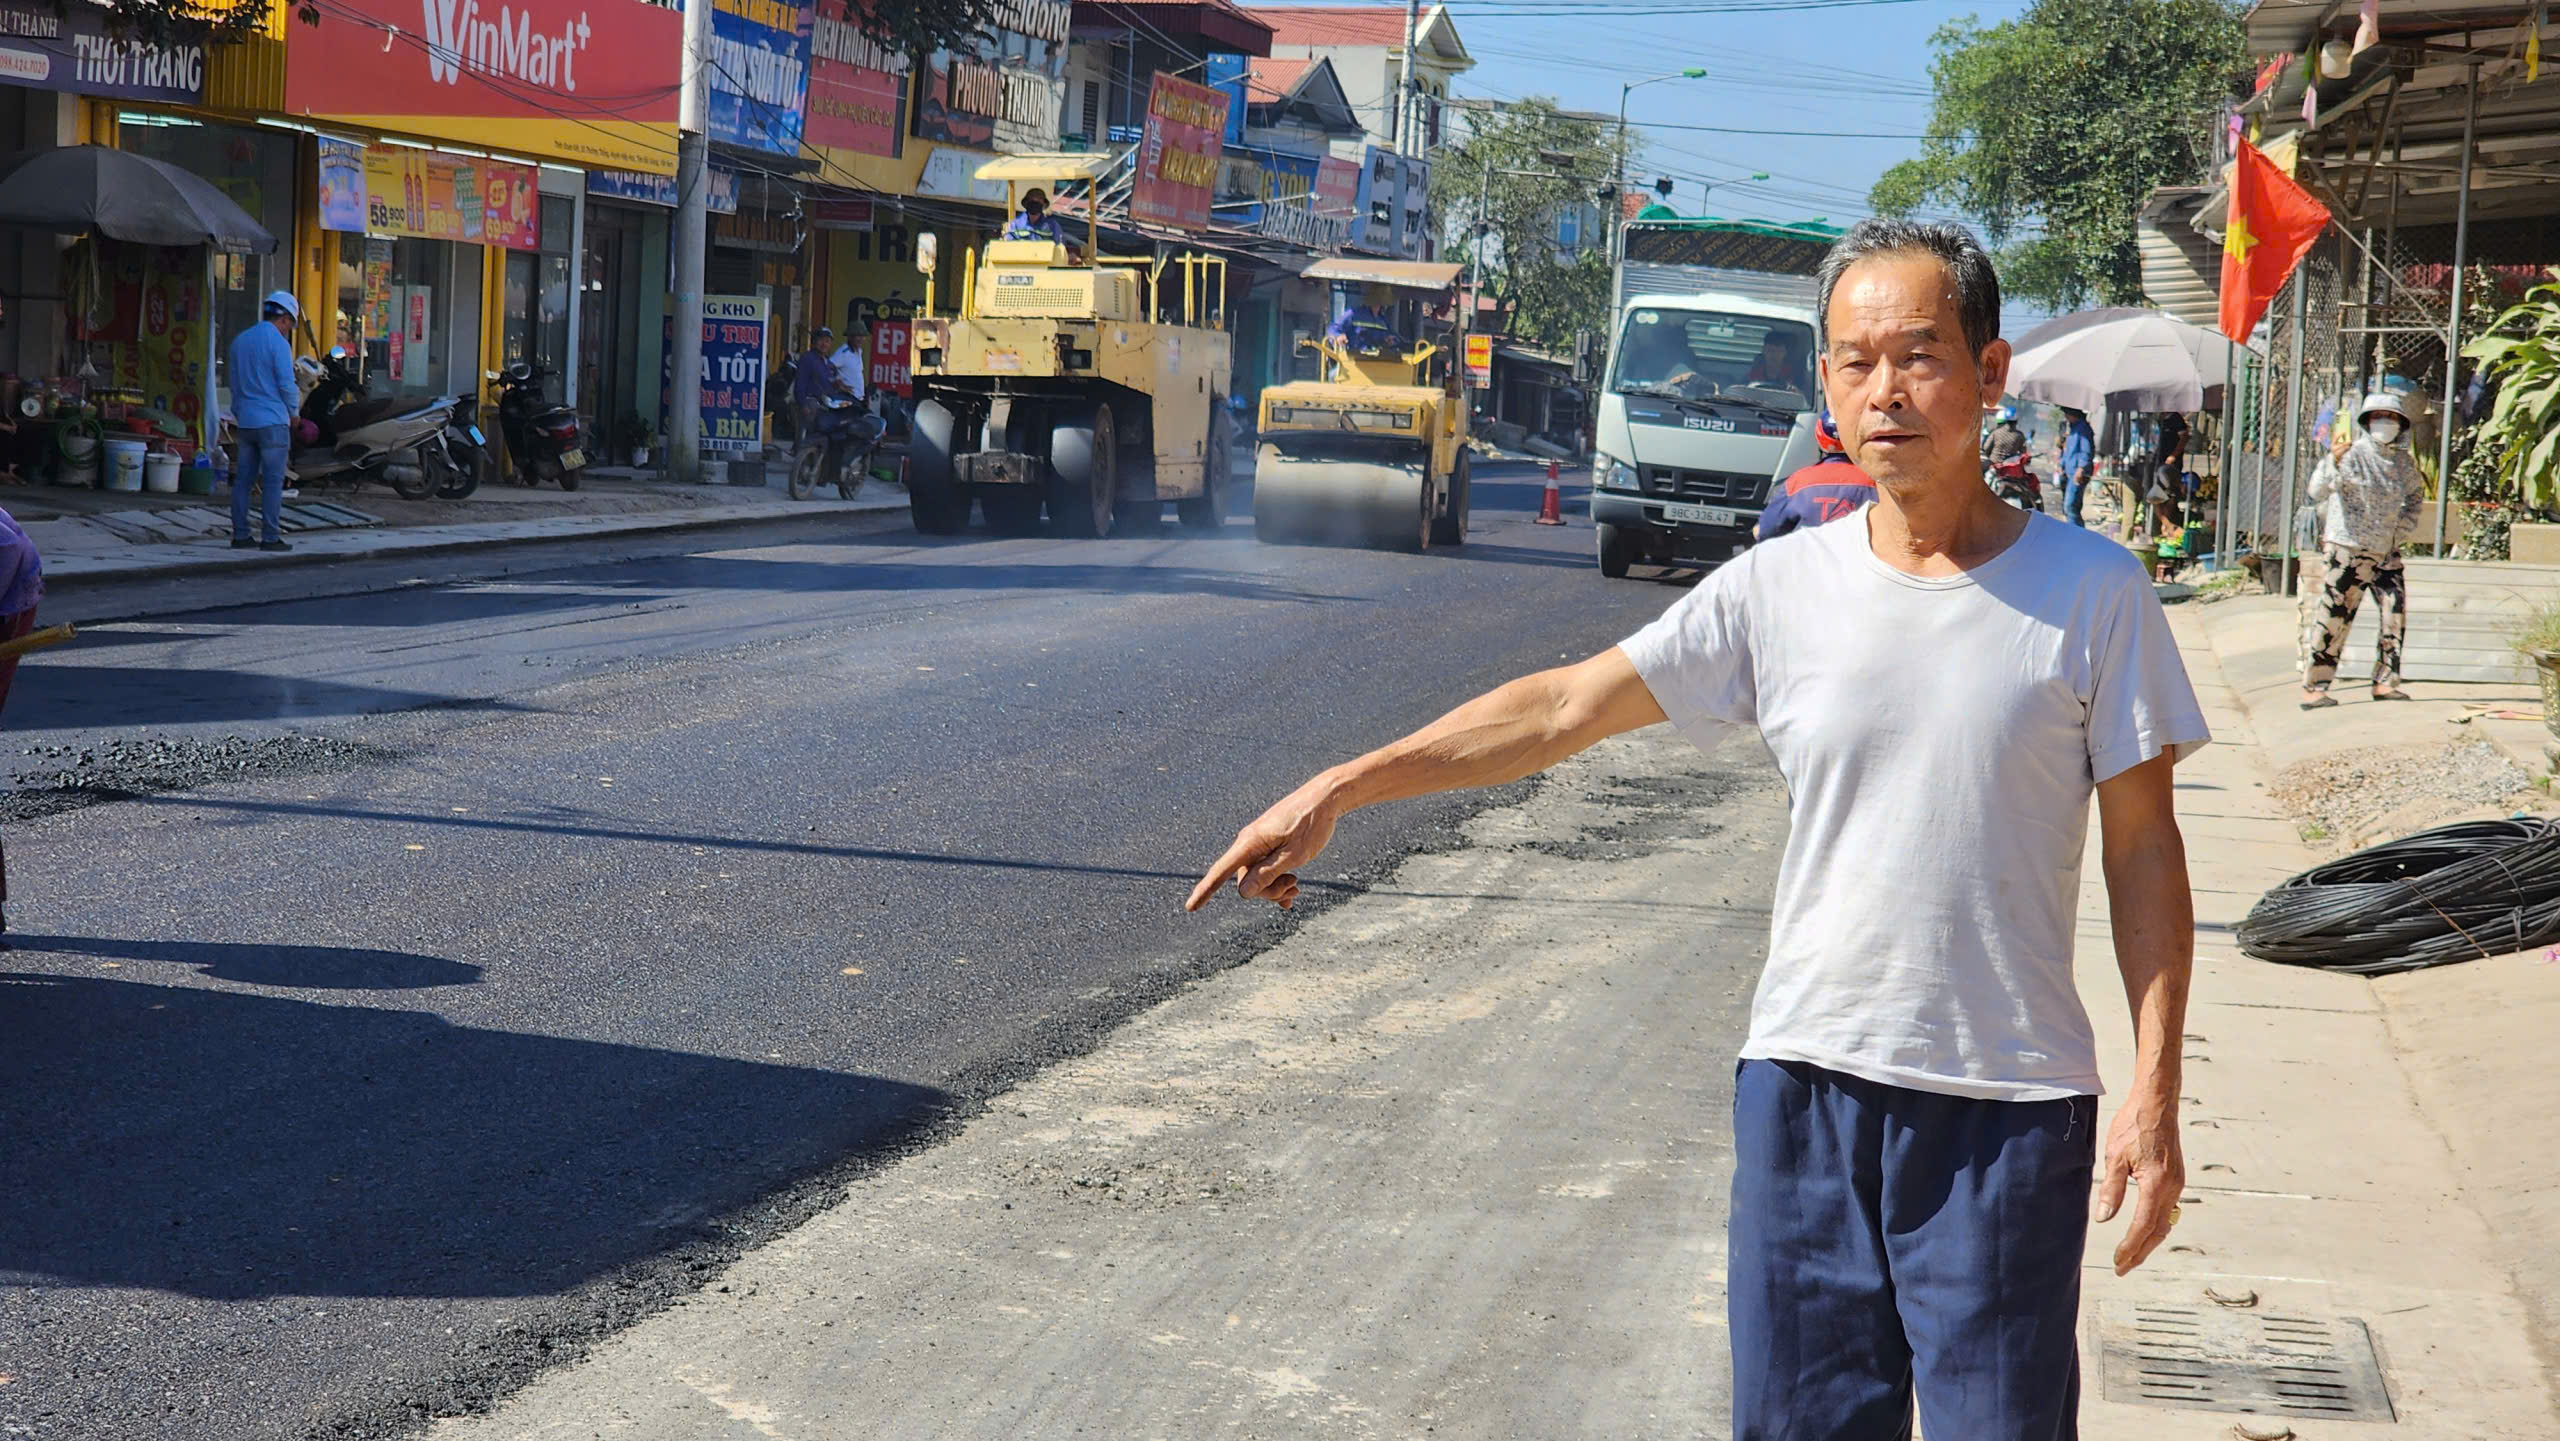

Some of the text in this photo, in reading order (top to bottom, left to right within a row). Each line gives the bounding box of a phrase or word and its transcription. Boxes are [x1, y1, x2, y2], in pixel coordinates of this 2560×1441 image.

[130, 40, 201, 93] TRANG
[722, 302, 755, 316] KHO
[721, 324, 761, 348] THỊ
[718, 348, 760, 383] TỐT
[715, 410, 756, 439] BỈM
[1683, 416, 1736, 433] ISUZU
